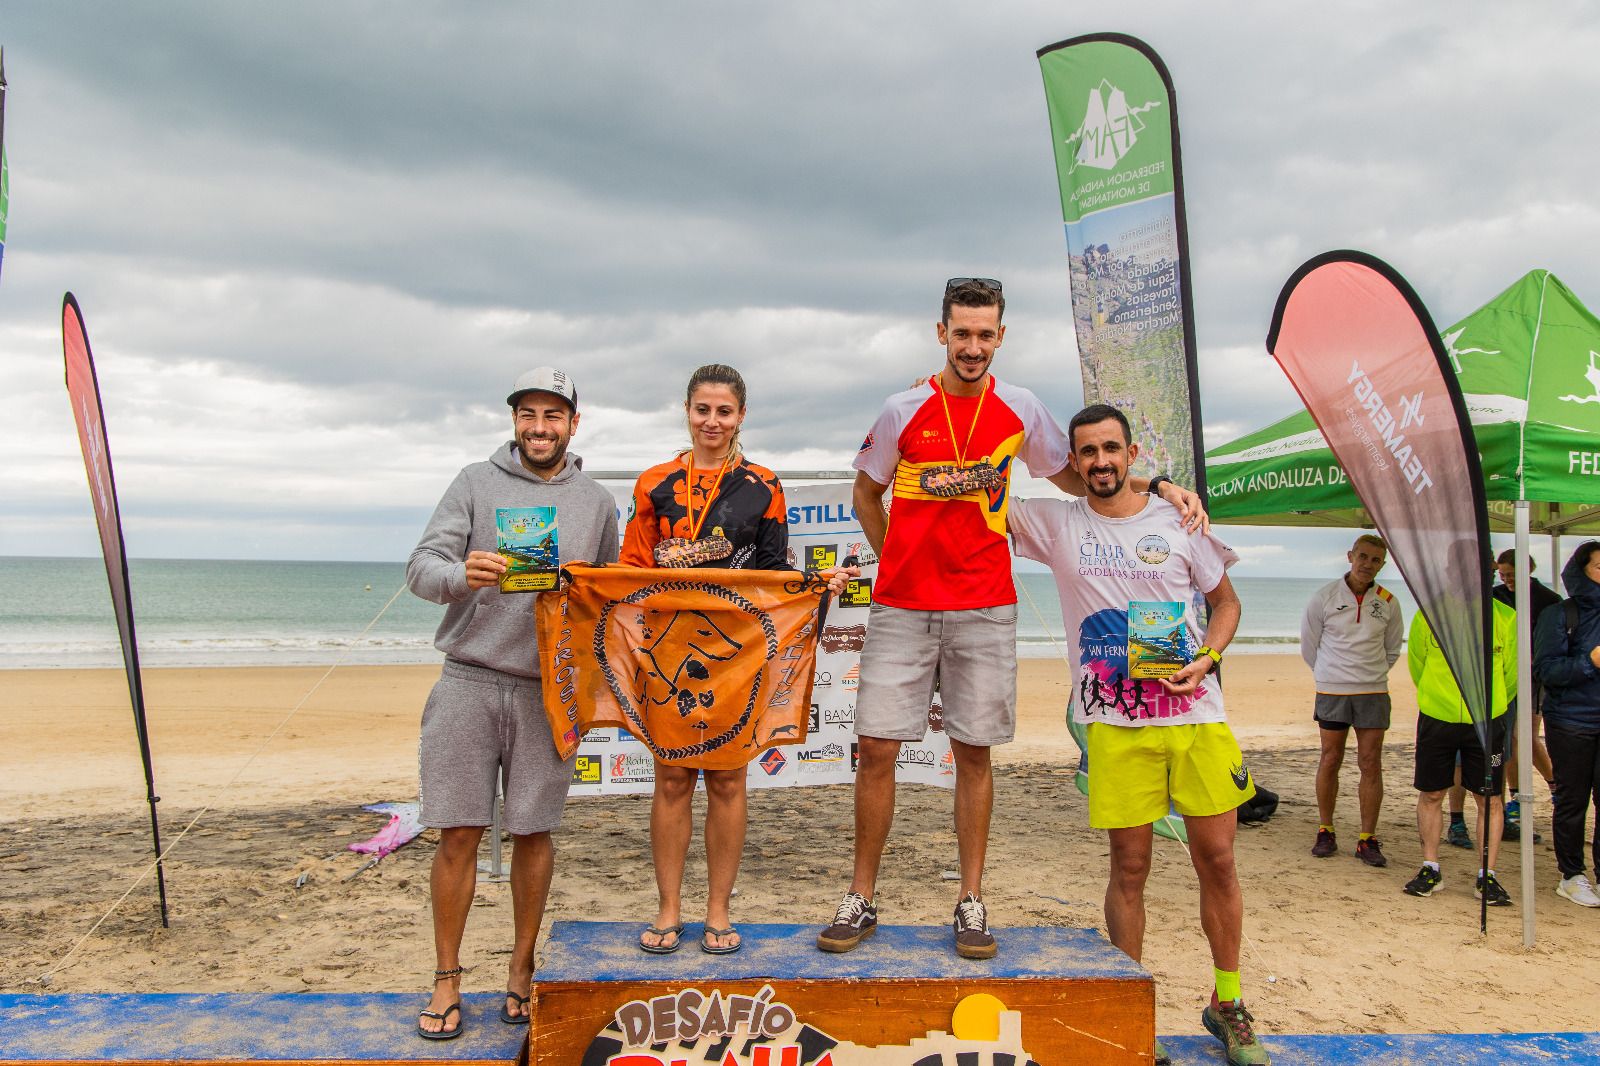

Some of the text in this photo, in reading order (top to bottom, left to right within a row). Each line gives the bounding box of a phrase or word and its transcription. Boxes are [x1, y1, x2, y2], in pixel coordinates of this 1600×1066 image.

[1247, 466, 1324, 493] ANDALUZA
[1080, 543, 1124, 559] CLUB
[824, 708, 857, 722] BAM
[616, 984, 796, 1048] DESAFÍO
